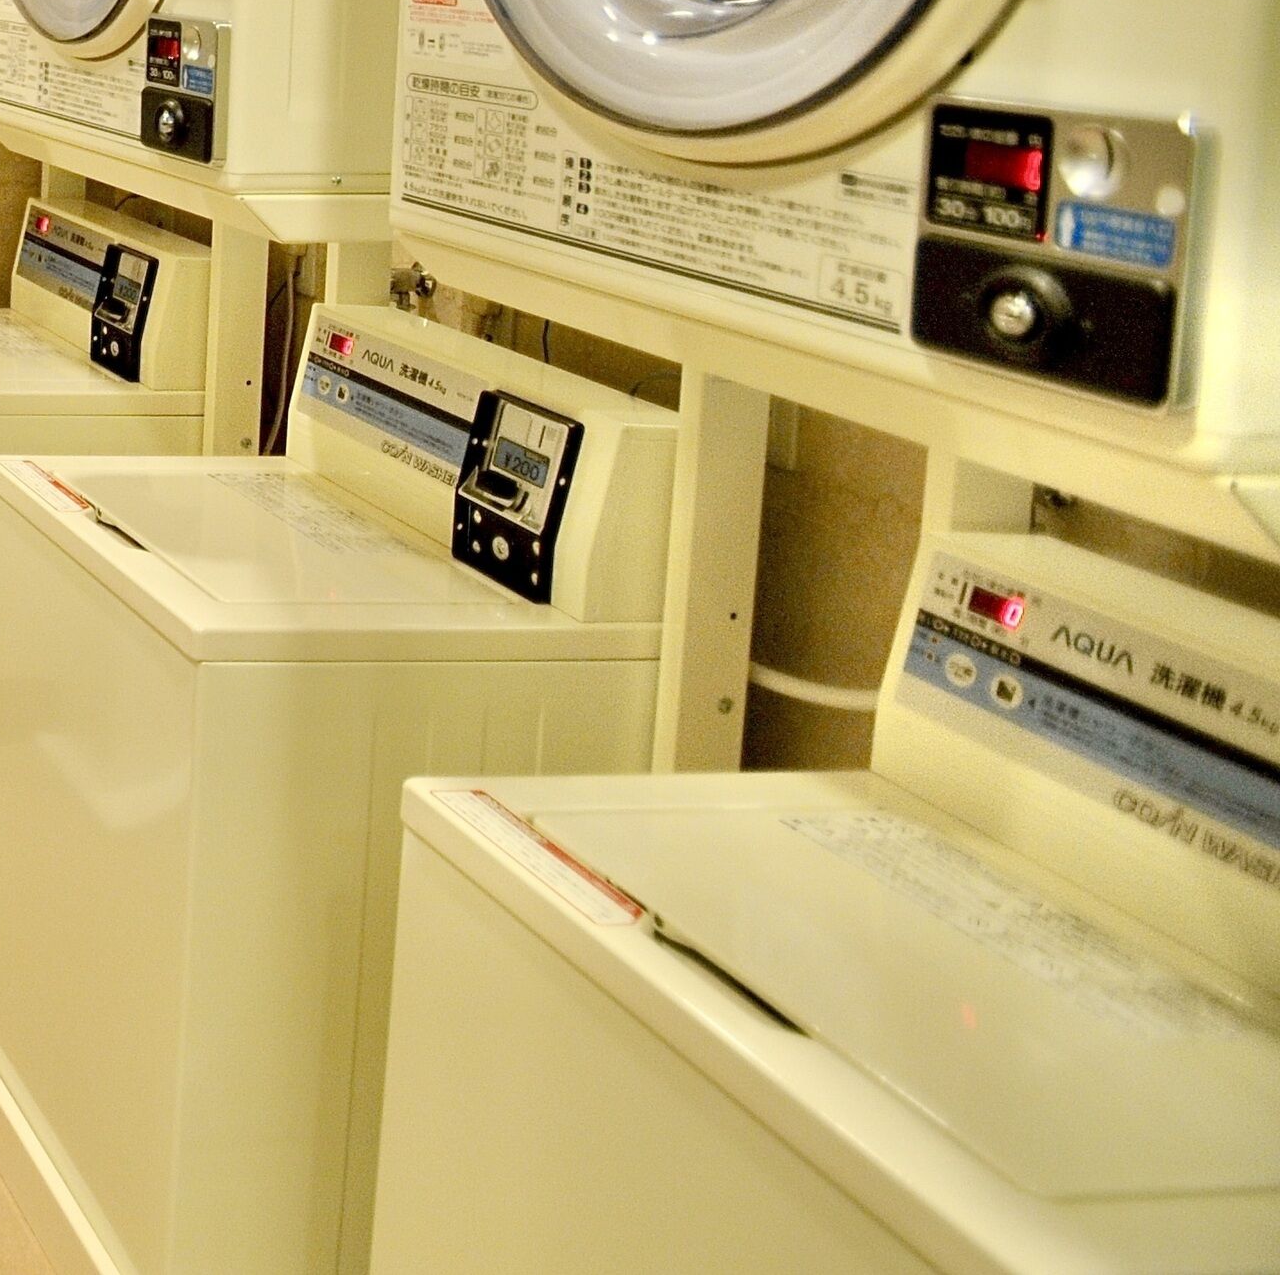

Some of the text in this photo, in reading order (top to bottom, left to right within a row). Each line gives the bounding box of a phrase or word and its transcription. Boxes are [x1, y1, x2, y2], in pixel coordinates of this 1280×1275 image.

[362, 348, 394, 373] AQUA
[1050, 624, 1135, 677] AQUA
[1149, 661, 1228, 713] 洗濯機
